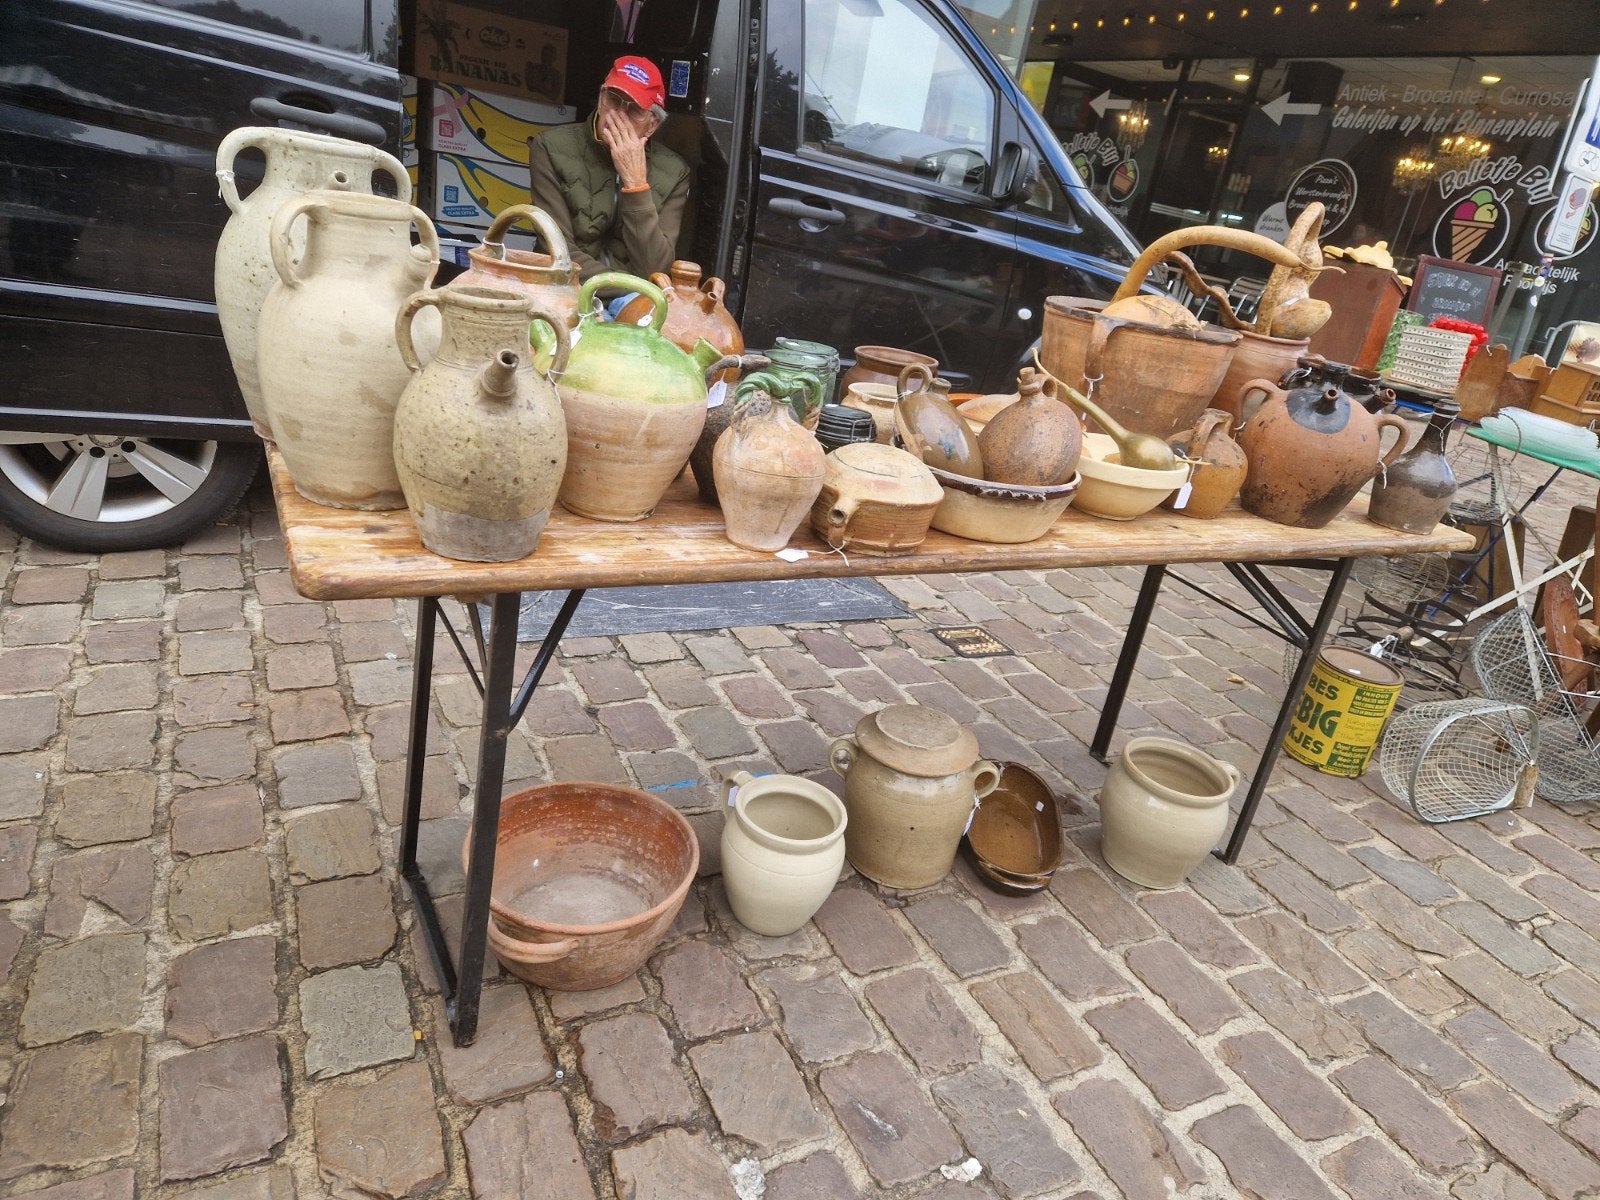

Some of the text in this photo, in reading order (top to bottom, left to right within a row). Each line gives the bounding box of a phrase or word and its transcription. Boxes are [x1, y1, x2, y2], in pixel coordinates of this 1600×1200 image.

[429, 54, 522, 88] BANANAS
[1337, 84, 1386, 103] Antiek
[1402, 85, 1483, 106] Brocante
[1332, 105, 1560, 142] Galerijen op het Binnenplein
[1439, 155, 1522, 200] Bolletje
